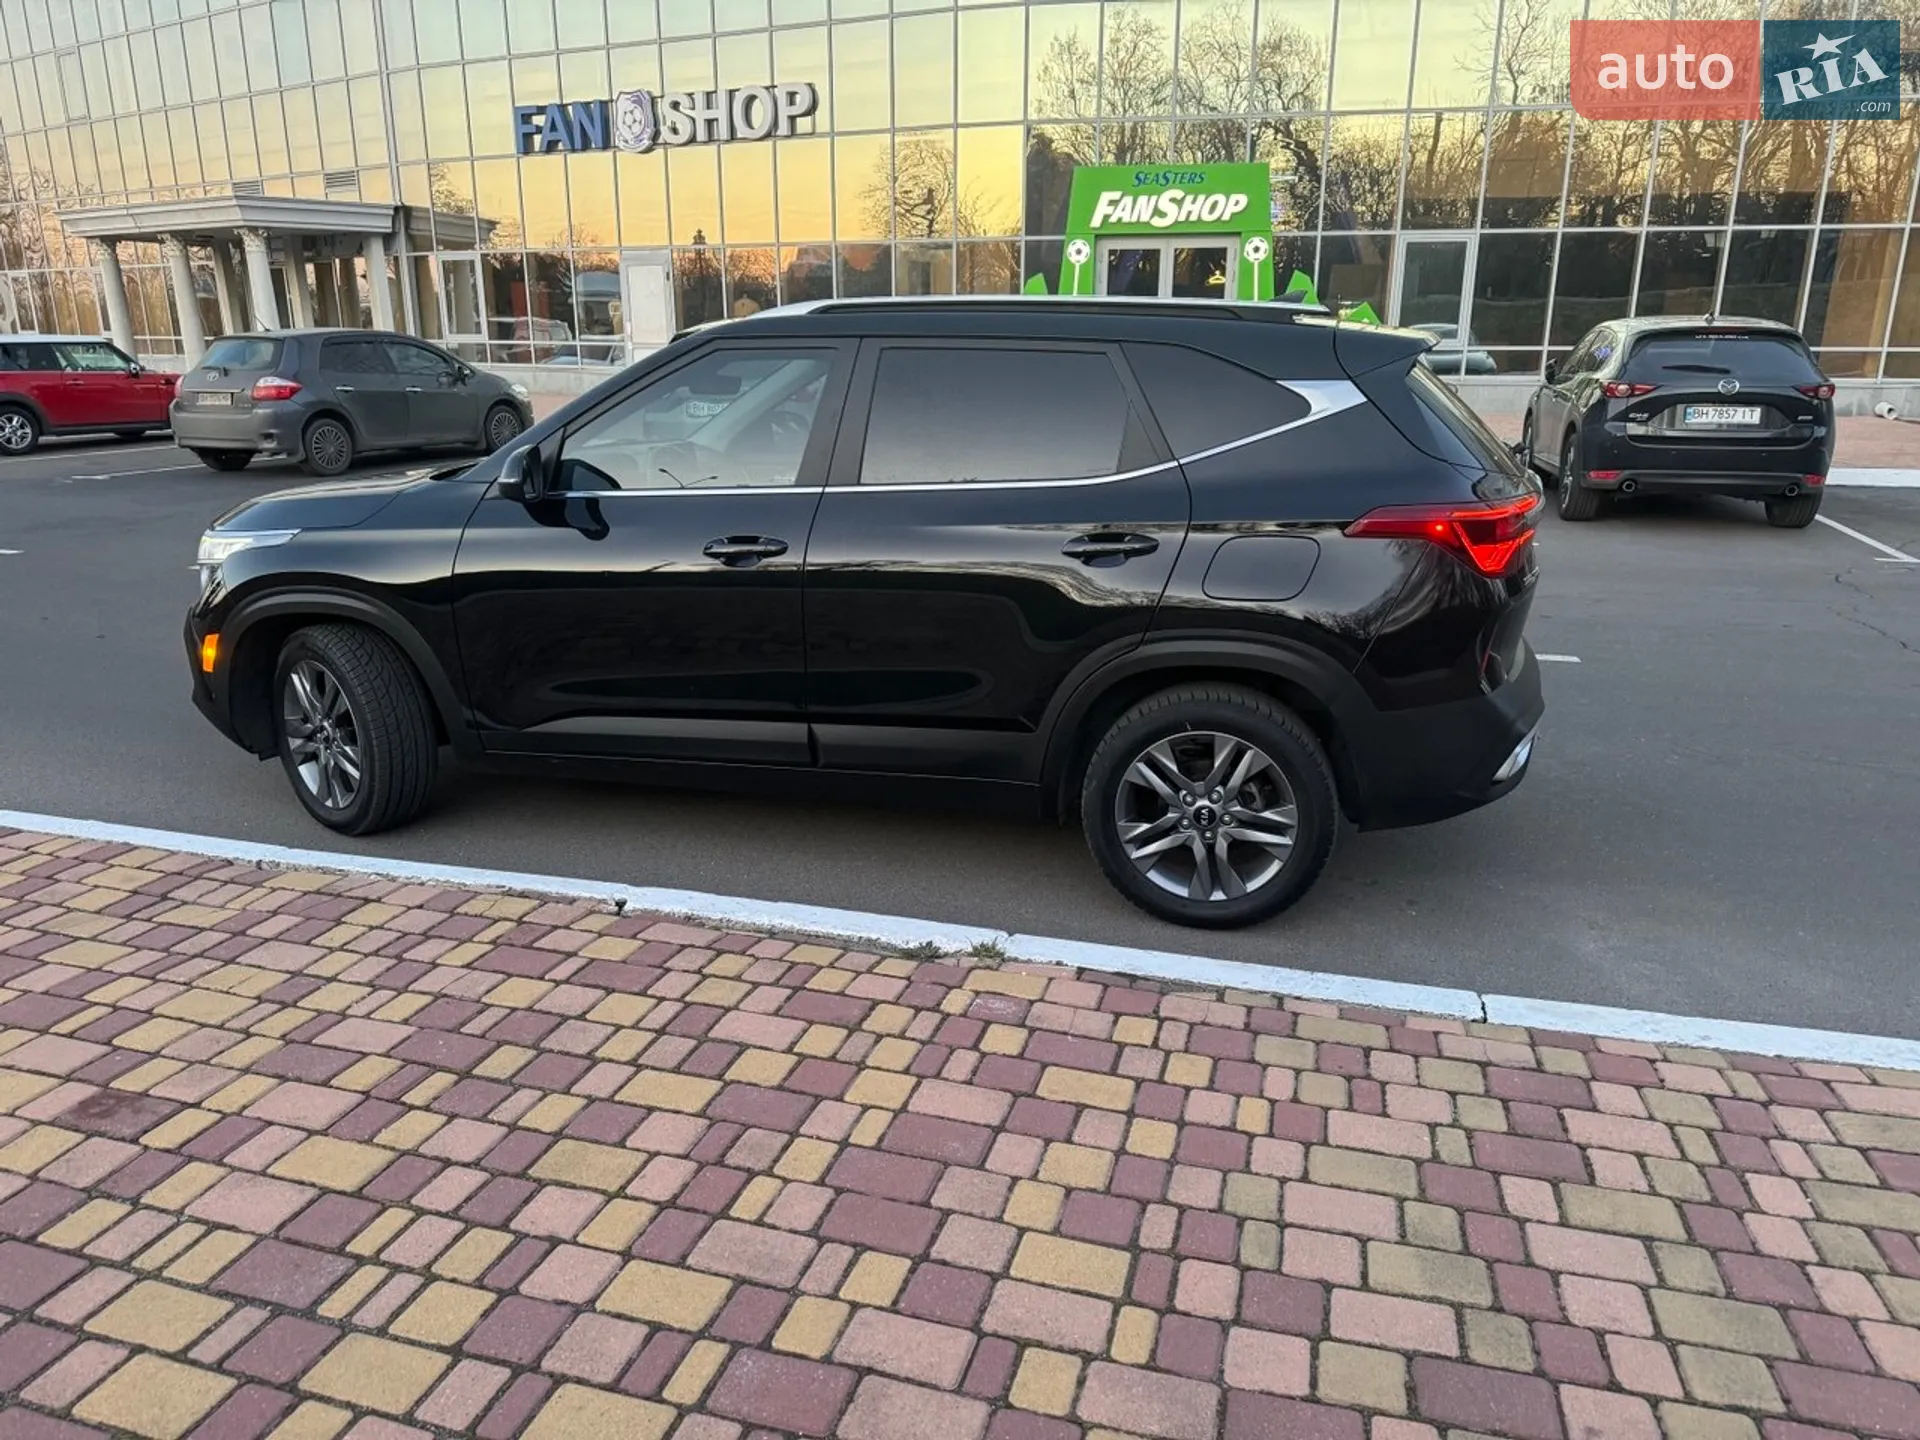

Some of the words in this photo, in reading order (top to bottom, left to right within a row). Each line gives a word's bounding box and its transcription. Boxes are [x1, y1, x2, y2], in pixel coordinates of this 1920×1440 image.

[514, 99, 611, 154] FAN
[661, 82, 818, 146] SHOP
[1693, 408, 1709, 420] BH
[1711, 408, 1738, 420] 7857
